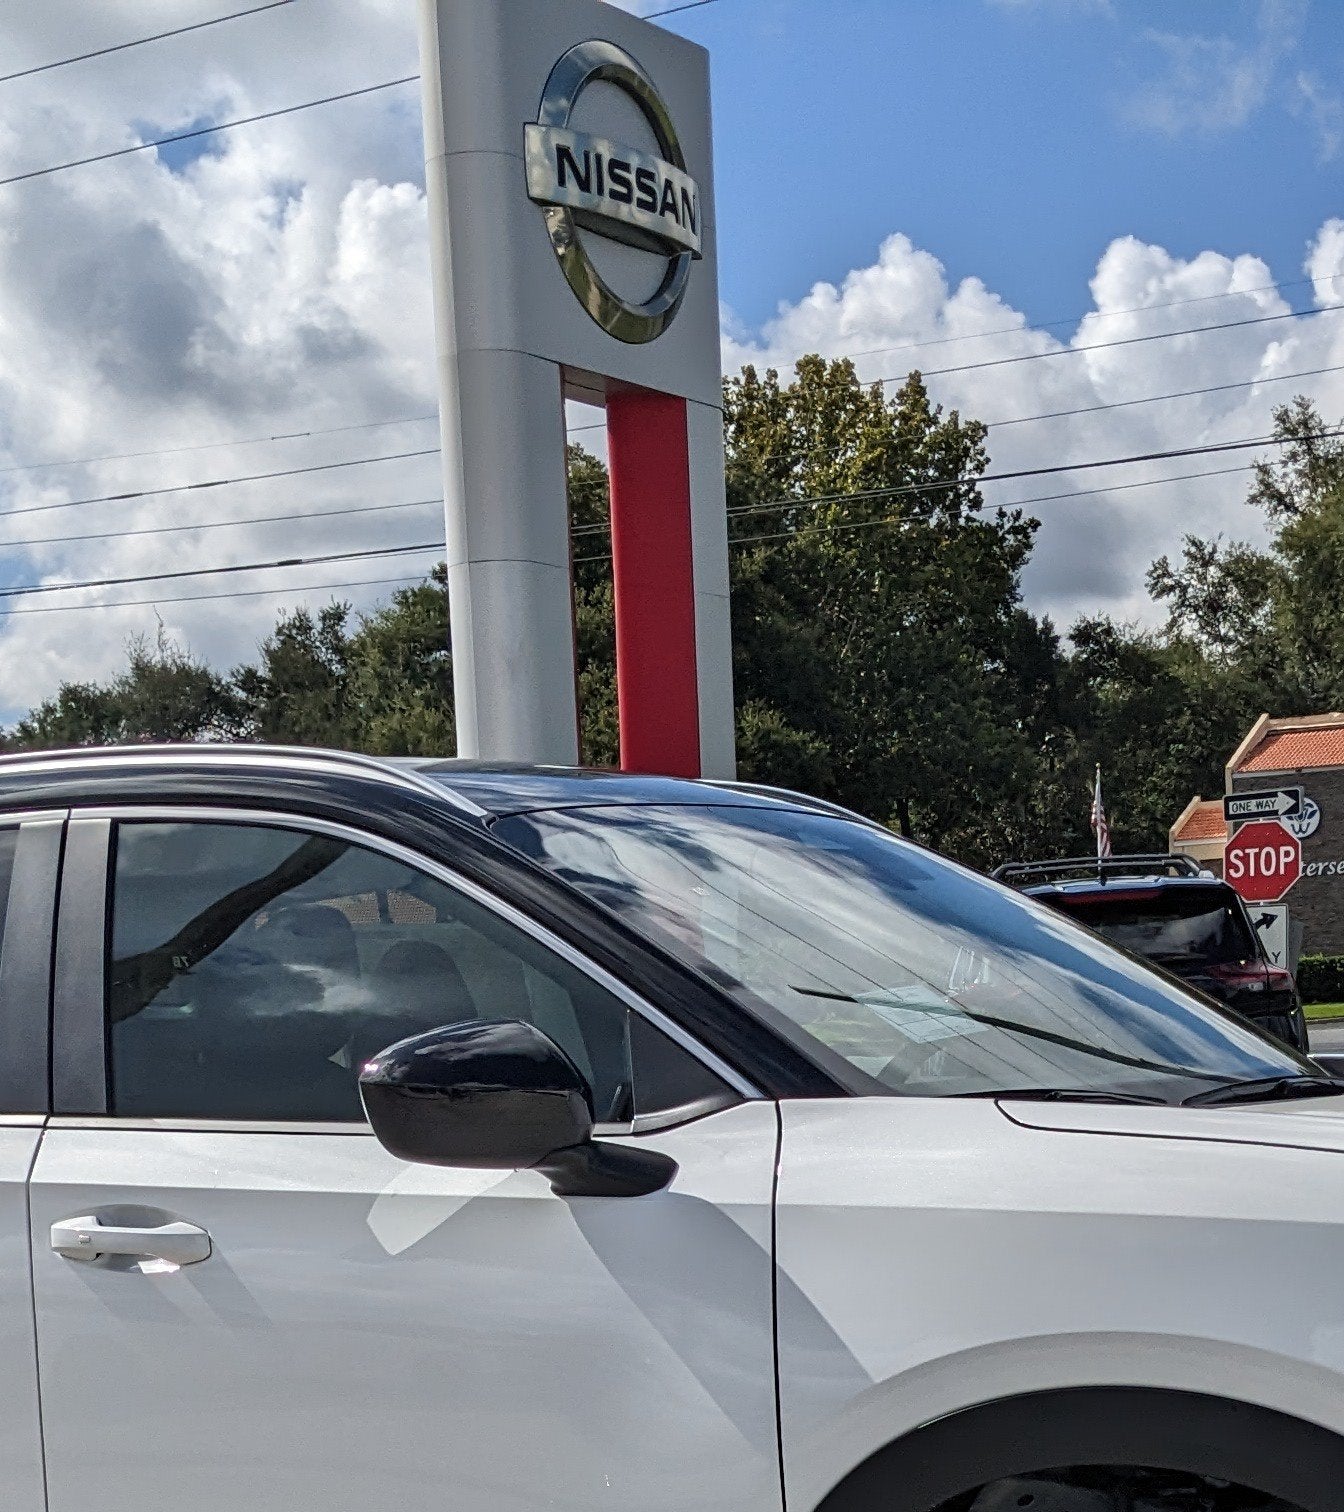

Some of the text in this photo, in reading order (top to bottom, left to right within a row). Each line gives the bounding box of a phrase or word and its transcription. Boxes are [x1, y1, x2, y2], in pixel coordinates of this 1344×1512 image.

[555, 144, 698, 236] NISSAN
[1231, 798, 1277, 813] ONE WAY
[1228, 845, 1296, 878] STOP
